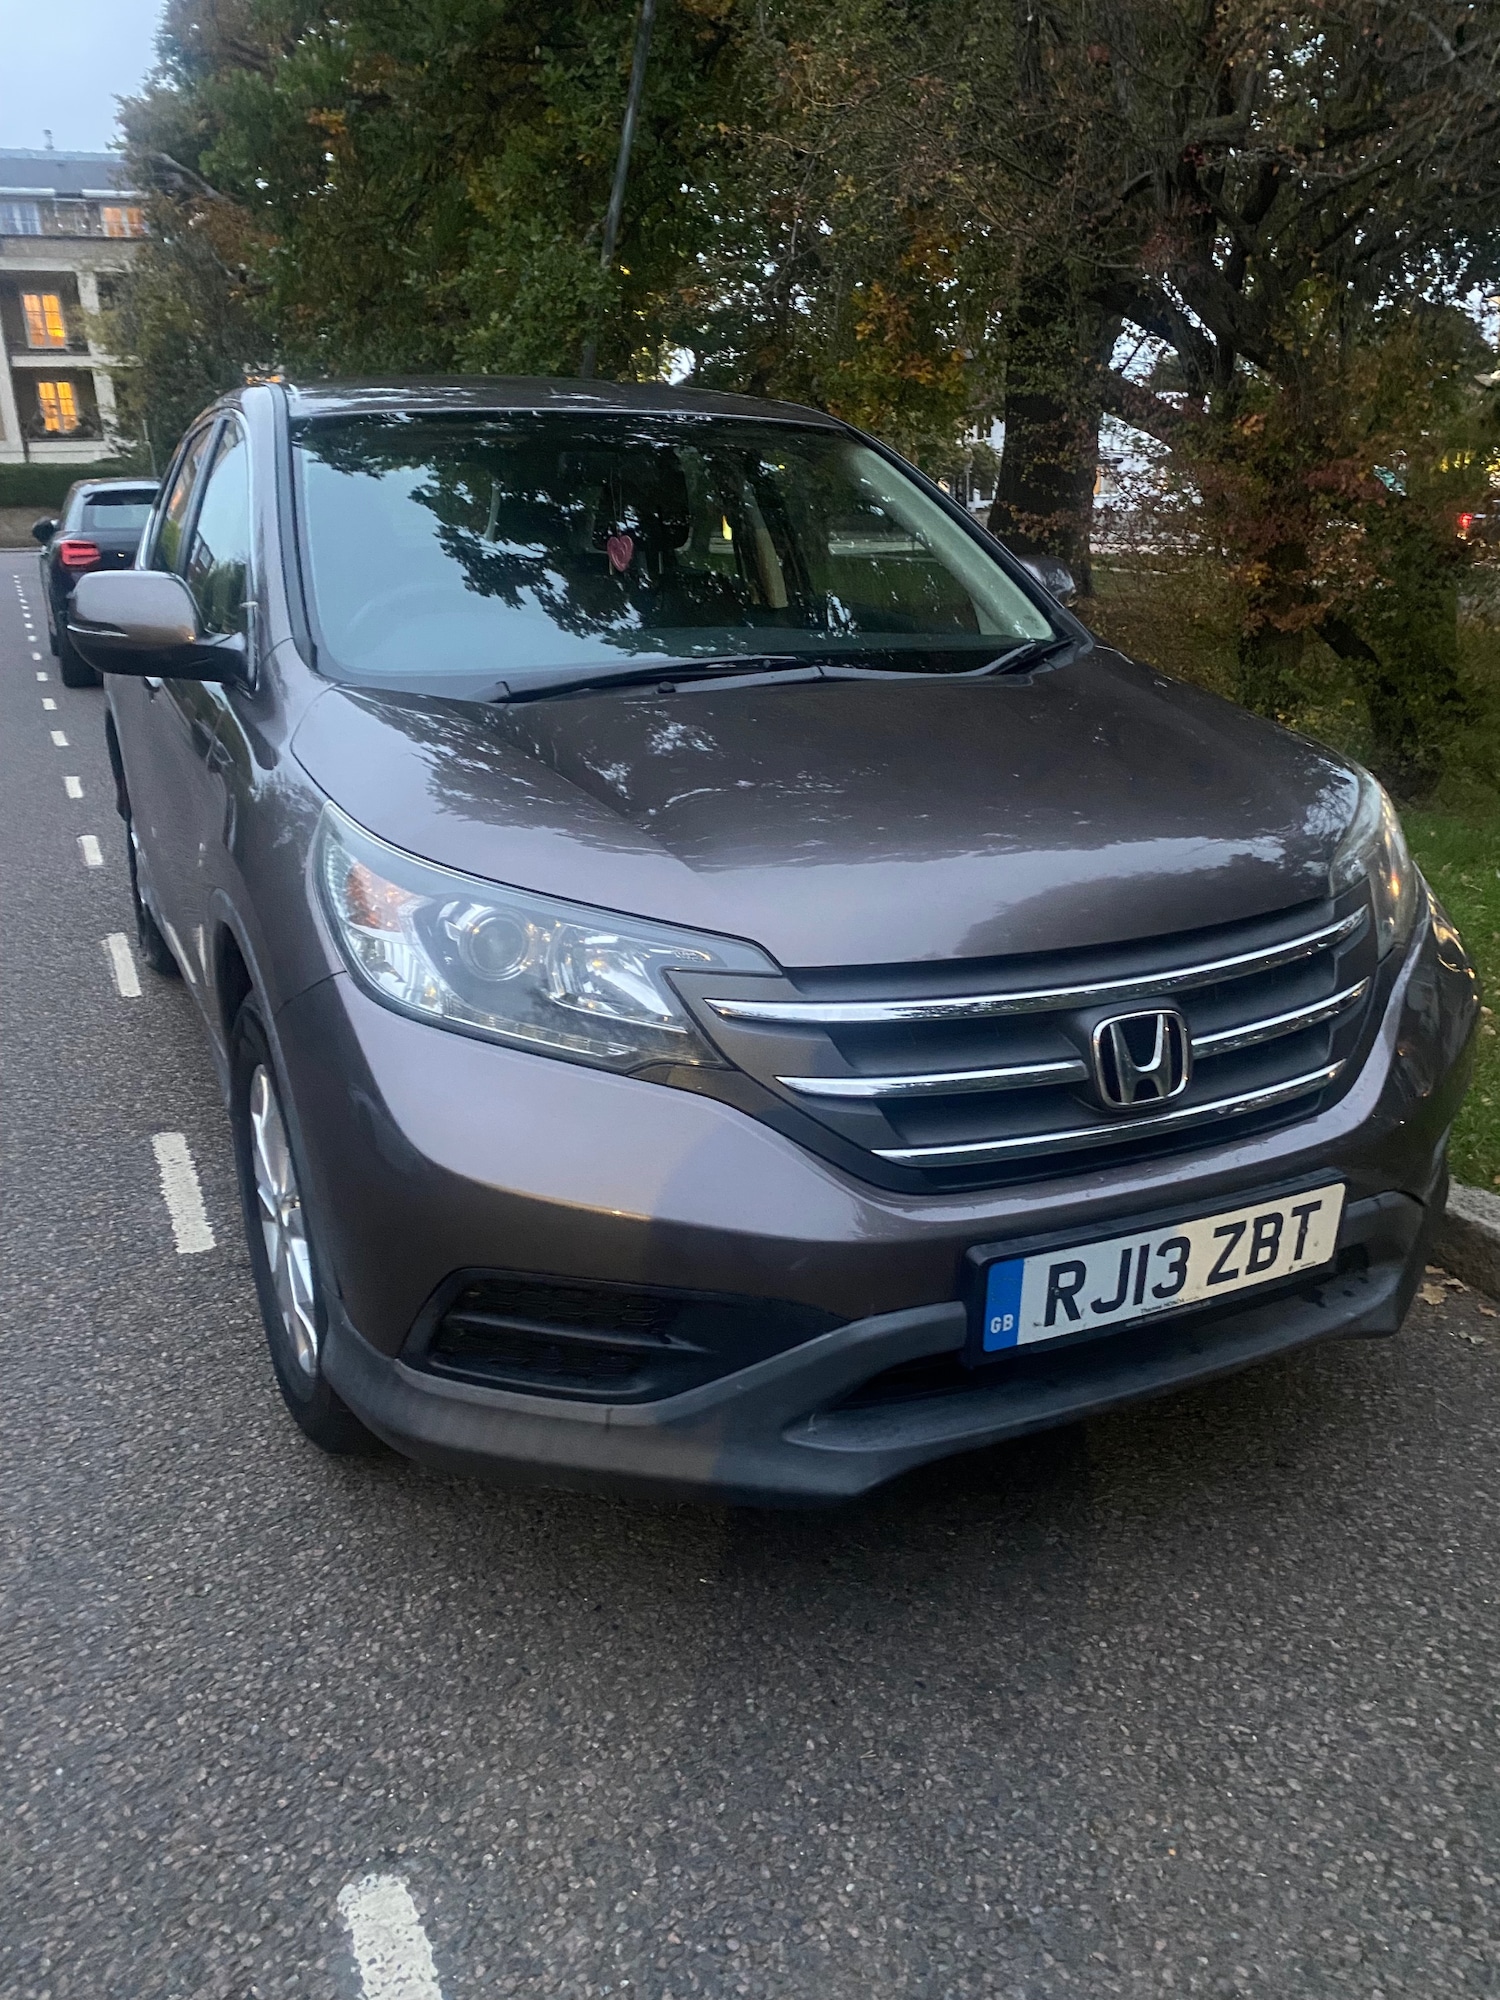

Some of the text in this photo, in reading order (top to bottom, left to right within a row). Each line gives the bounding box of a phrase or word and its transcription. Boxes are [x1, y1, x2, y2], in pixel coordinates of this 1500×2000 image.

[1044, 1200, 1322, 1327] RJ13 ZBT
[990, 1313, 1014, 1334] GB
